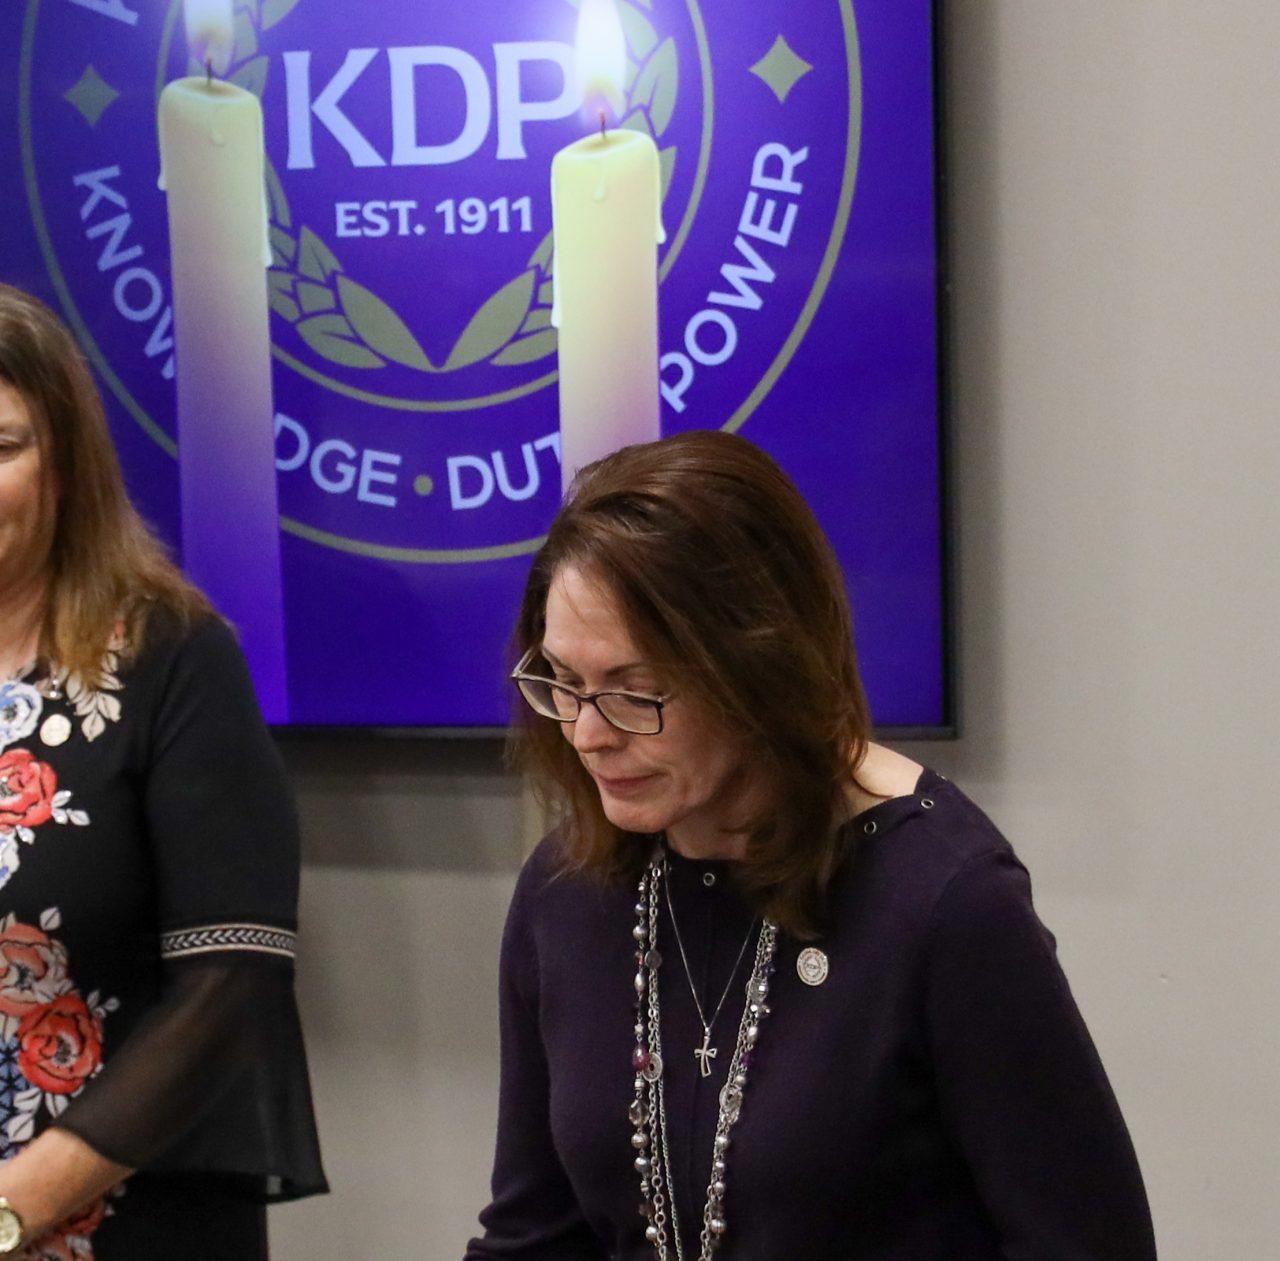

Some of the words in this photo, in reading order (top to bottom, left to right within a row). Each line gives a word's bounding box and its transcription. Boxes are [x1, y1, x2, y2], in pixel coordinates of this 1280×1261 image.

[282, 41, 587, 170] KDP
[335, 199, 426, 238] EST.
[435, 196, 533, 235] 1911
[659, 142, 809, 413] POWER
